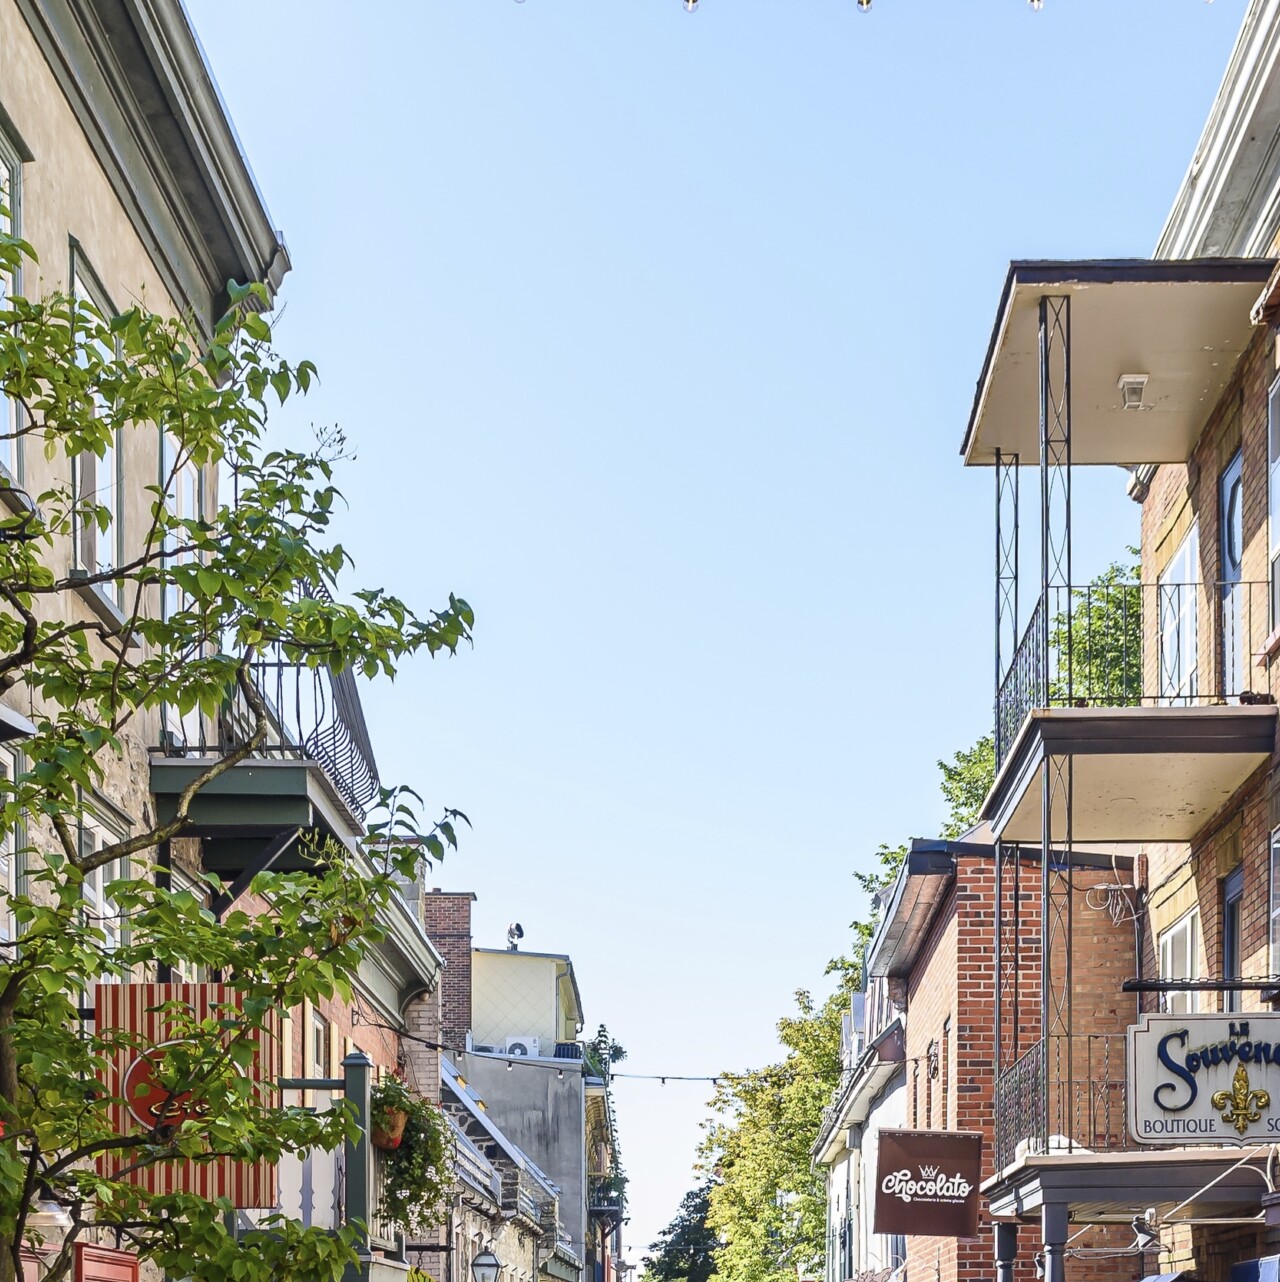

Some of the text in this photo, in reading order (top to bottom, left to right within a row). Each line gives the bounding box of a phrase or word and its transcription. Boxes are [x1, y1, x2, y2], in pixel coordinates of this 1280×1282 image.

[1229, 1020, 1250, 1037] LE
[1143, 1118, 1217, 1135] BOUTIQUE
[881, 1168, 974, 1203] Chocolato
